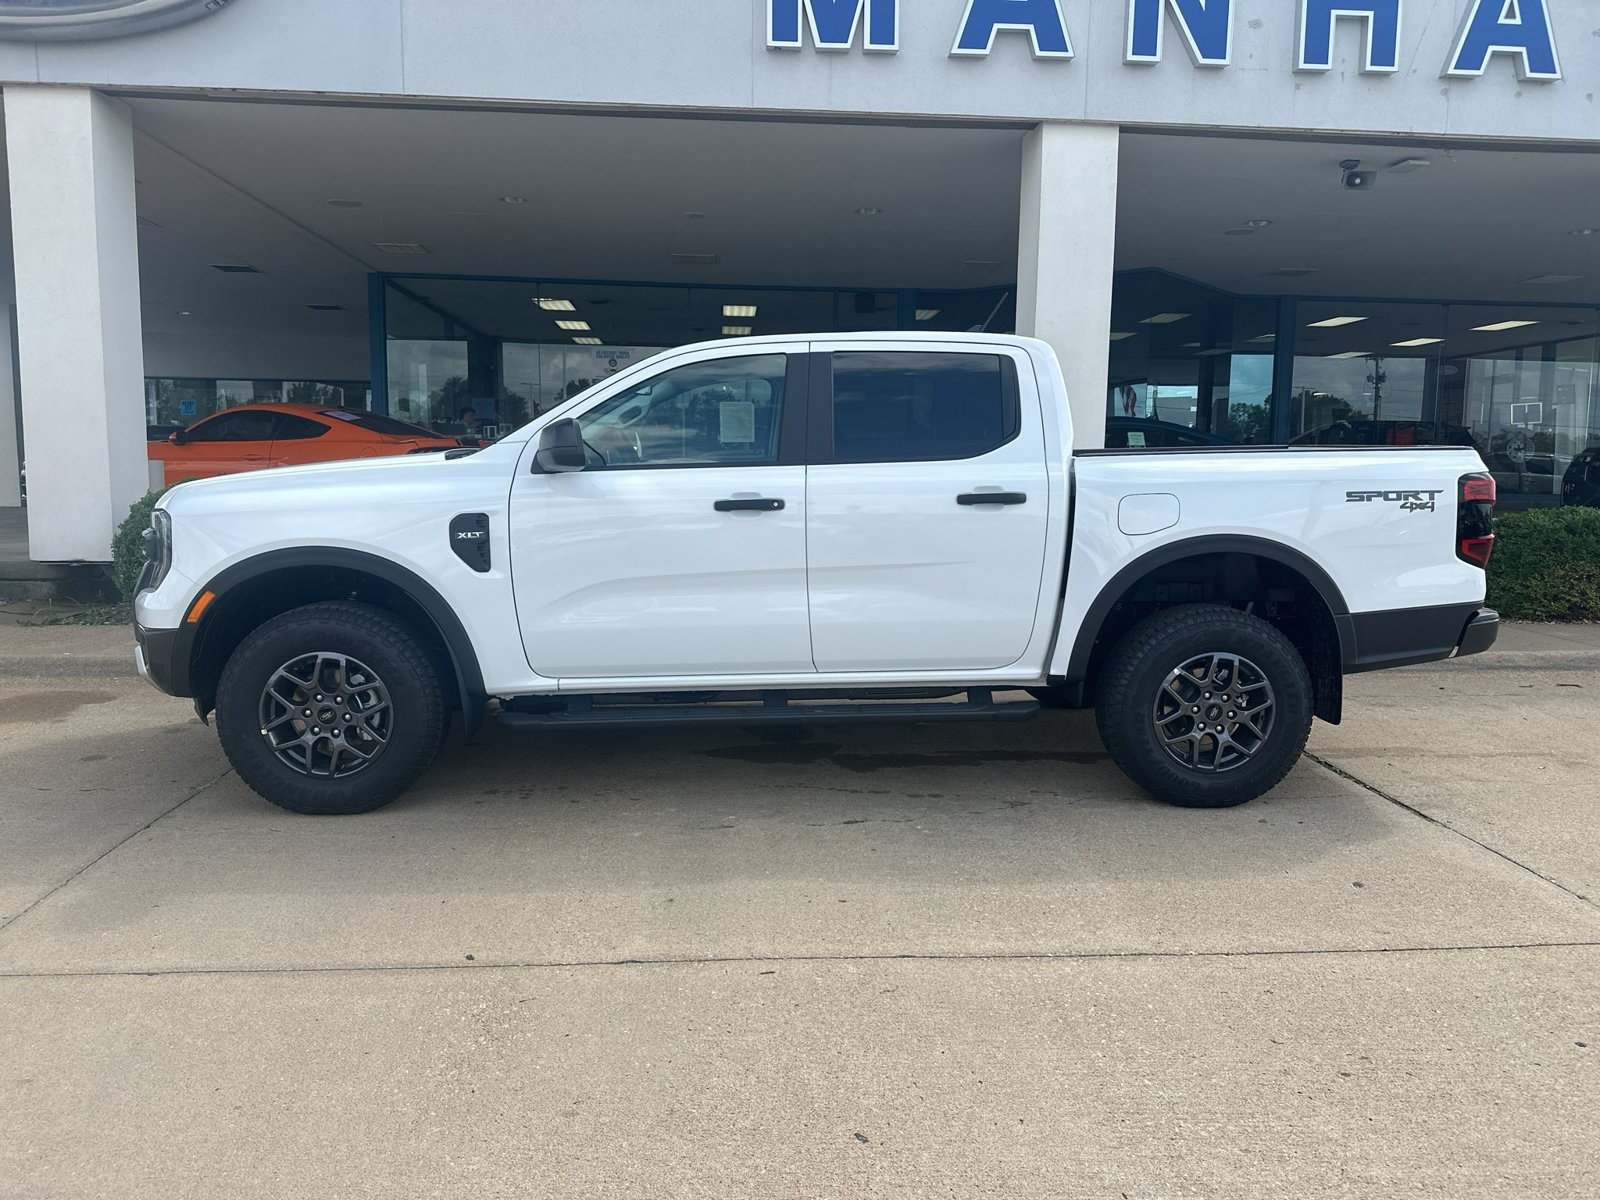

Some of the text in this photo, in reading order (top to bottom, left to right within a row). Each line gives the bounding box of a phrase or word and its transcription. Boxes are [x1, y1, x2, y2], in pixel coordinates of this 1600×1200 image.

[1345, 490, 1444, 502] SPORT
[1399, 501, 1435, 513] 4x4
[457, 531, 484, 539] XLT
